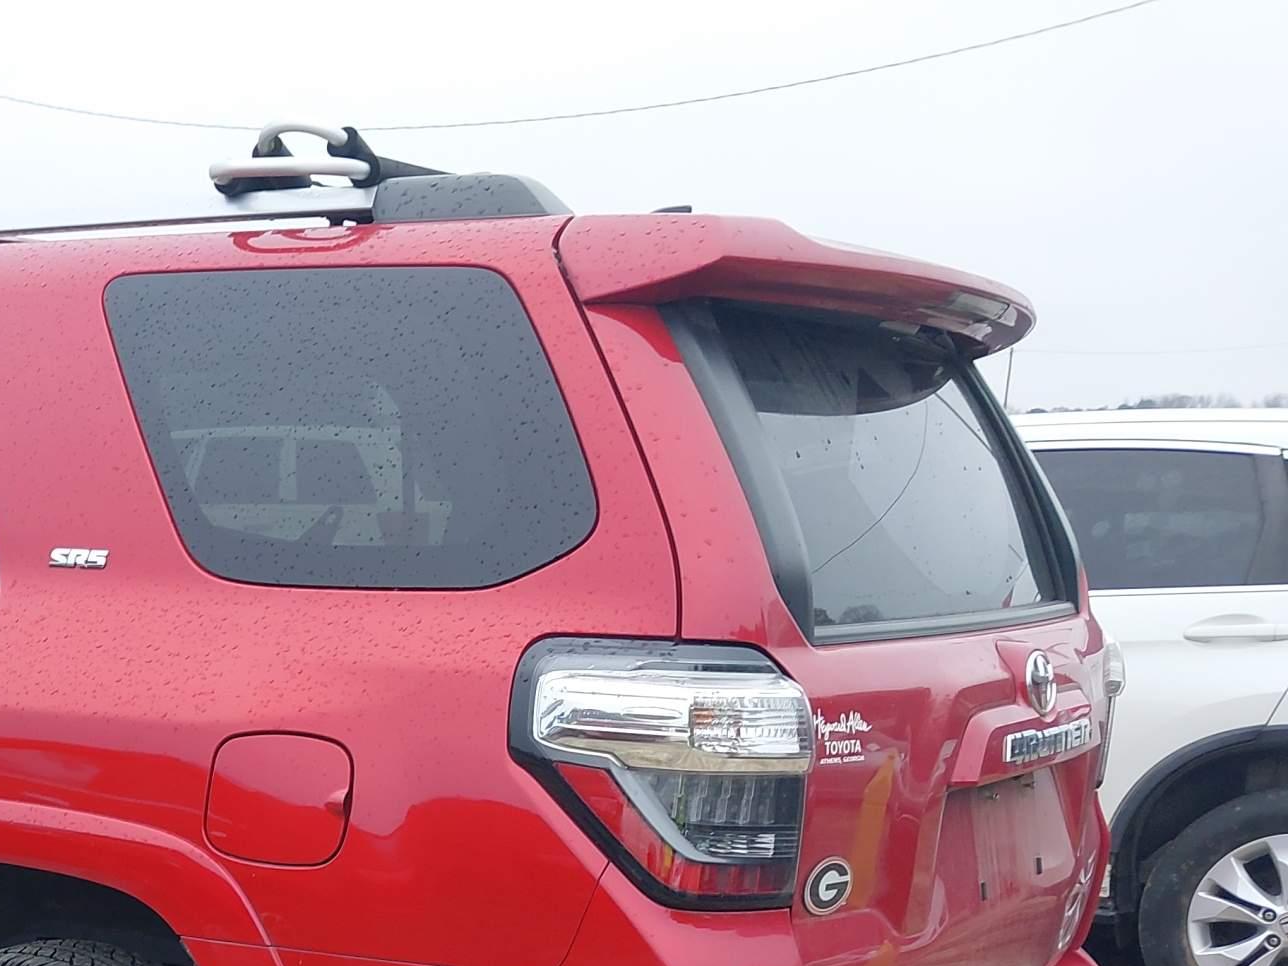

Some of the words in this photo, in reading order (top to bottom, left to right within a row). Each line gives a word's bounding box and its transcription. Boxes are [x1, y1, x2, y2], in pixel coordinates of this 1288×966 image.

[48, 547, 109, 569] SR5
[824, 739, 861, 755] TOYOTA
[808, 862, 851, 910] G
